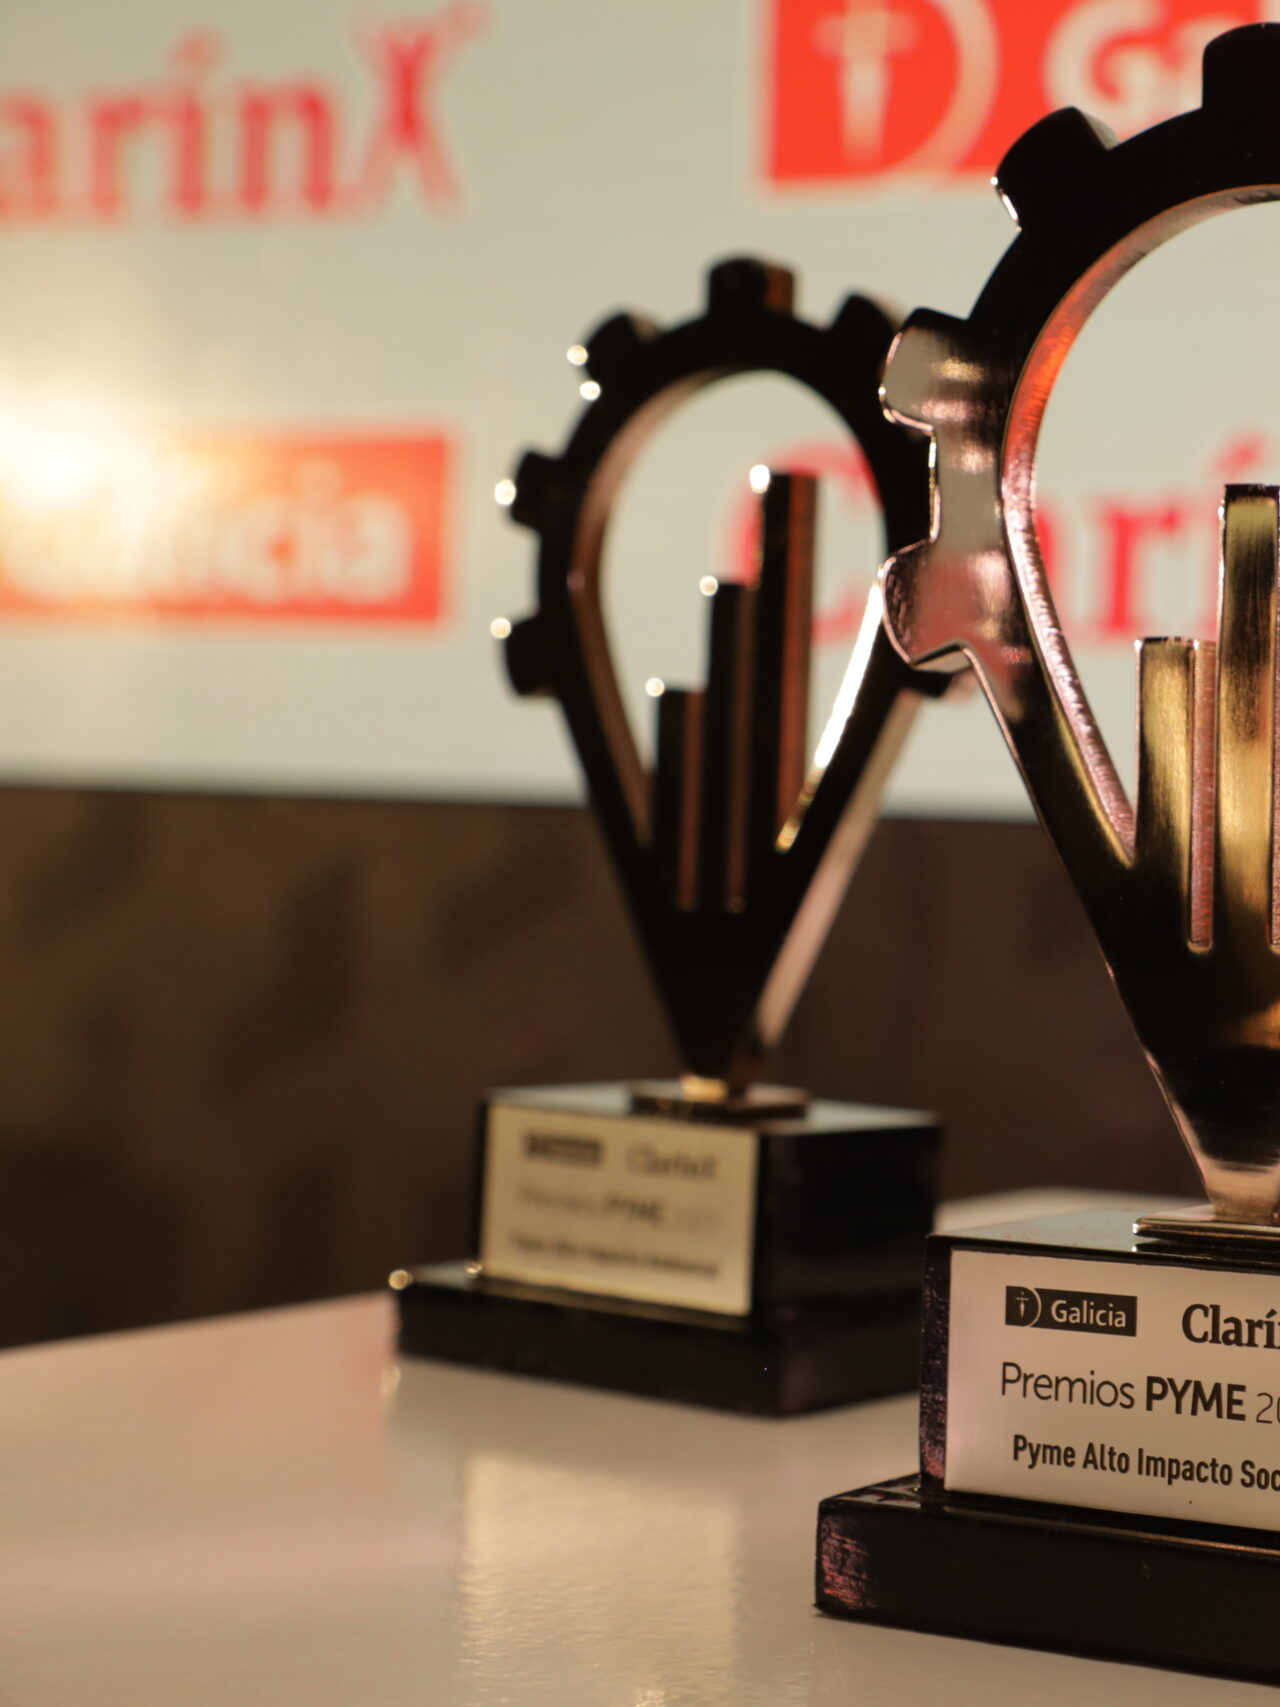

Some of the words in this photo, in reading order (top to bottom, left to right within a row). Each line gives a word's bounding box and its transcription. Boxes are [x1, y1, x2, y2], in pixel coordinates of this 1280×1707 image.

[1051, 1299, 1126, 1328] Galicia
[1001, 1361, 1135, 1409] Premios
[1146, 1375, 1247, 1422] PYME
[1012, 1434, 1076, 1469] Pyme
[1082, 1442, 1130, 1474] Alto
[1137, 1448, 1233, 1485] Impacto
